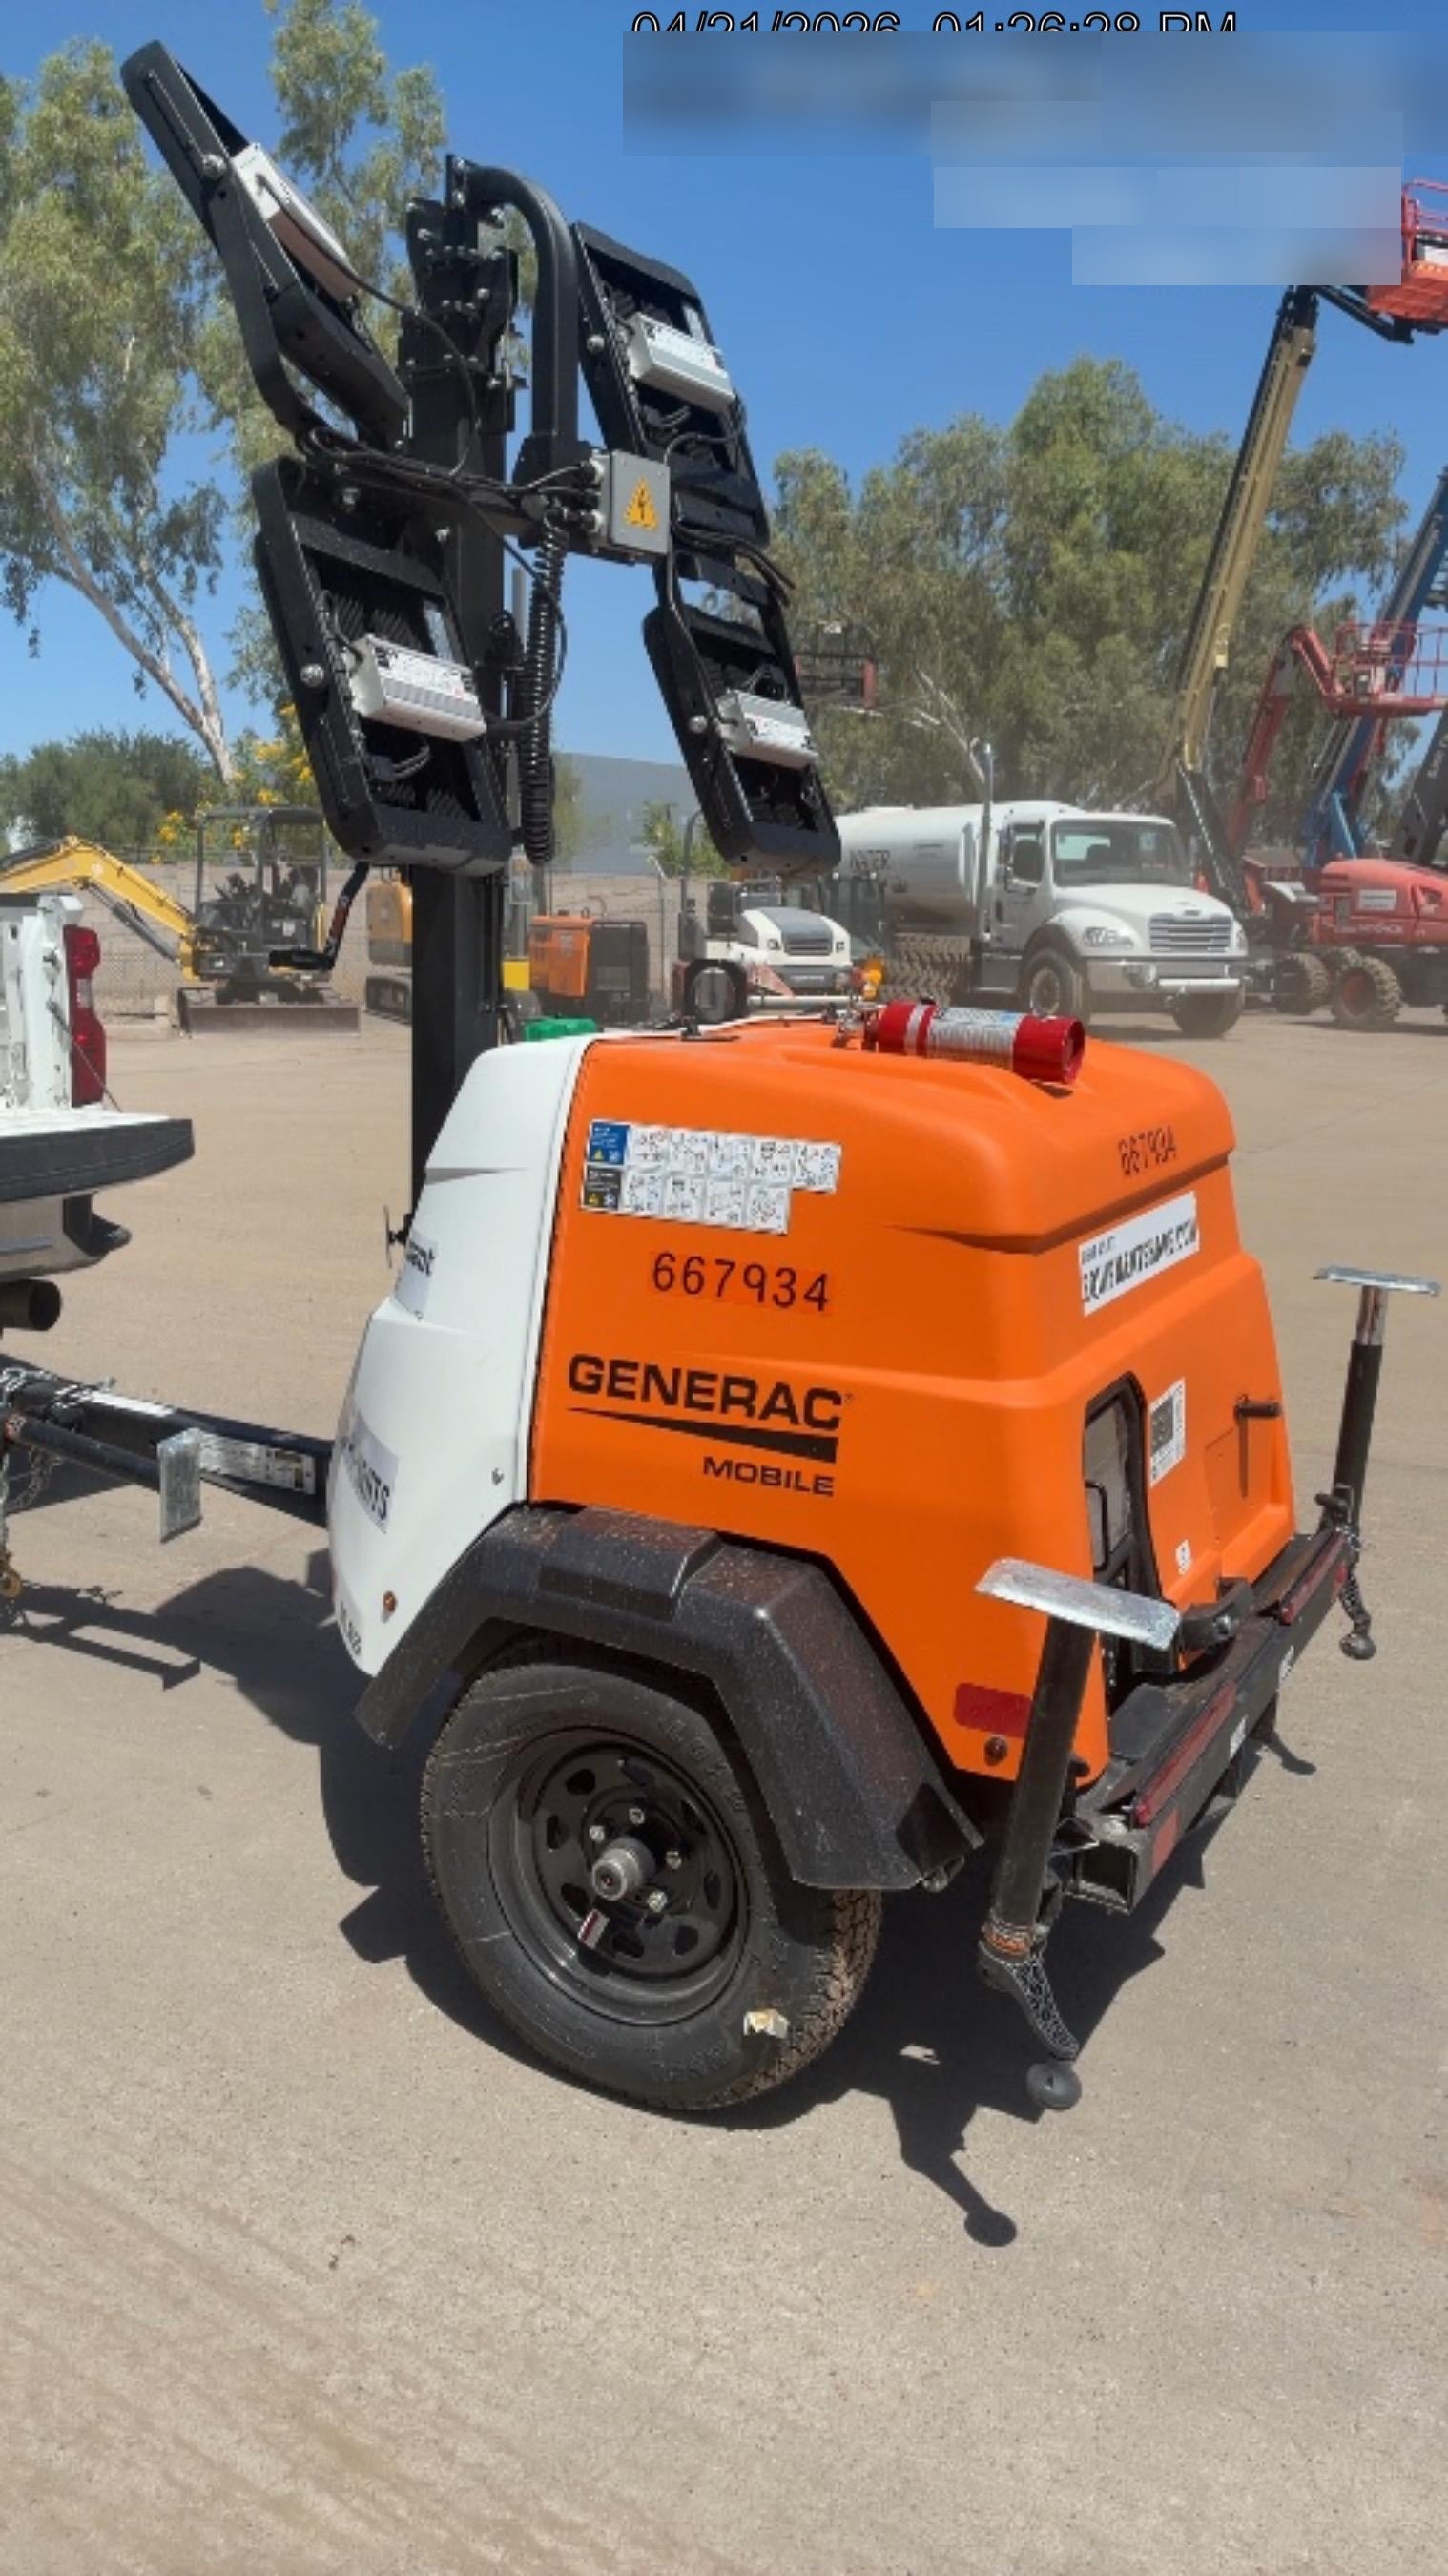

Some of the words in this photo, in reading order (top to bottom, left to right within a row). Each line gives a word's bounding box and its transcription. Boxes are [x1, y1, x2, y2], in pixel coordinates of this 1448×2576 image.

[652, 1252, 828, 1313] 667934
[568, 1353, 843, 1431] GENERAC
[703, 1456, 835, 1497] MOBILE
